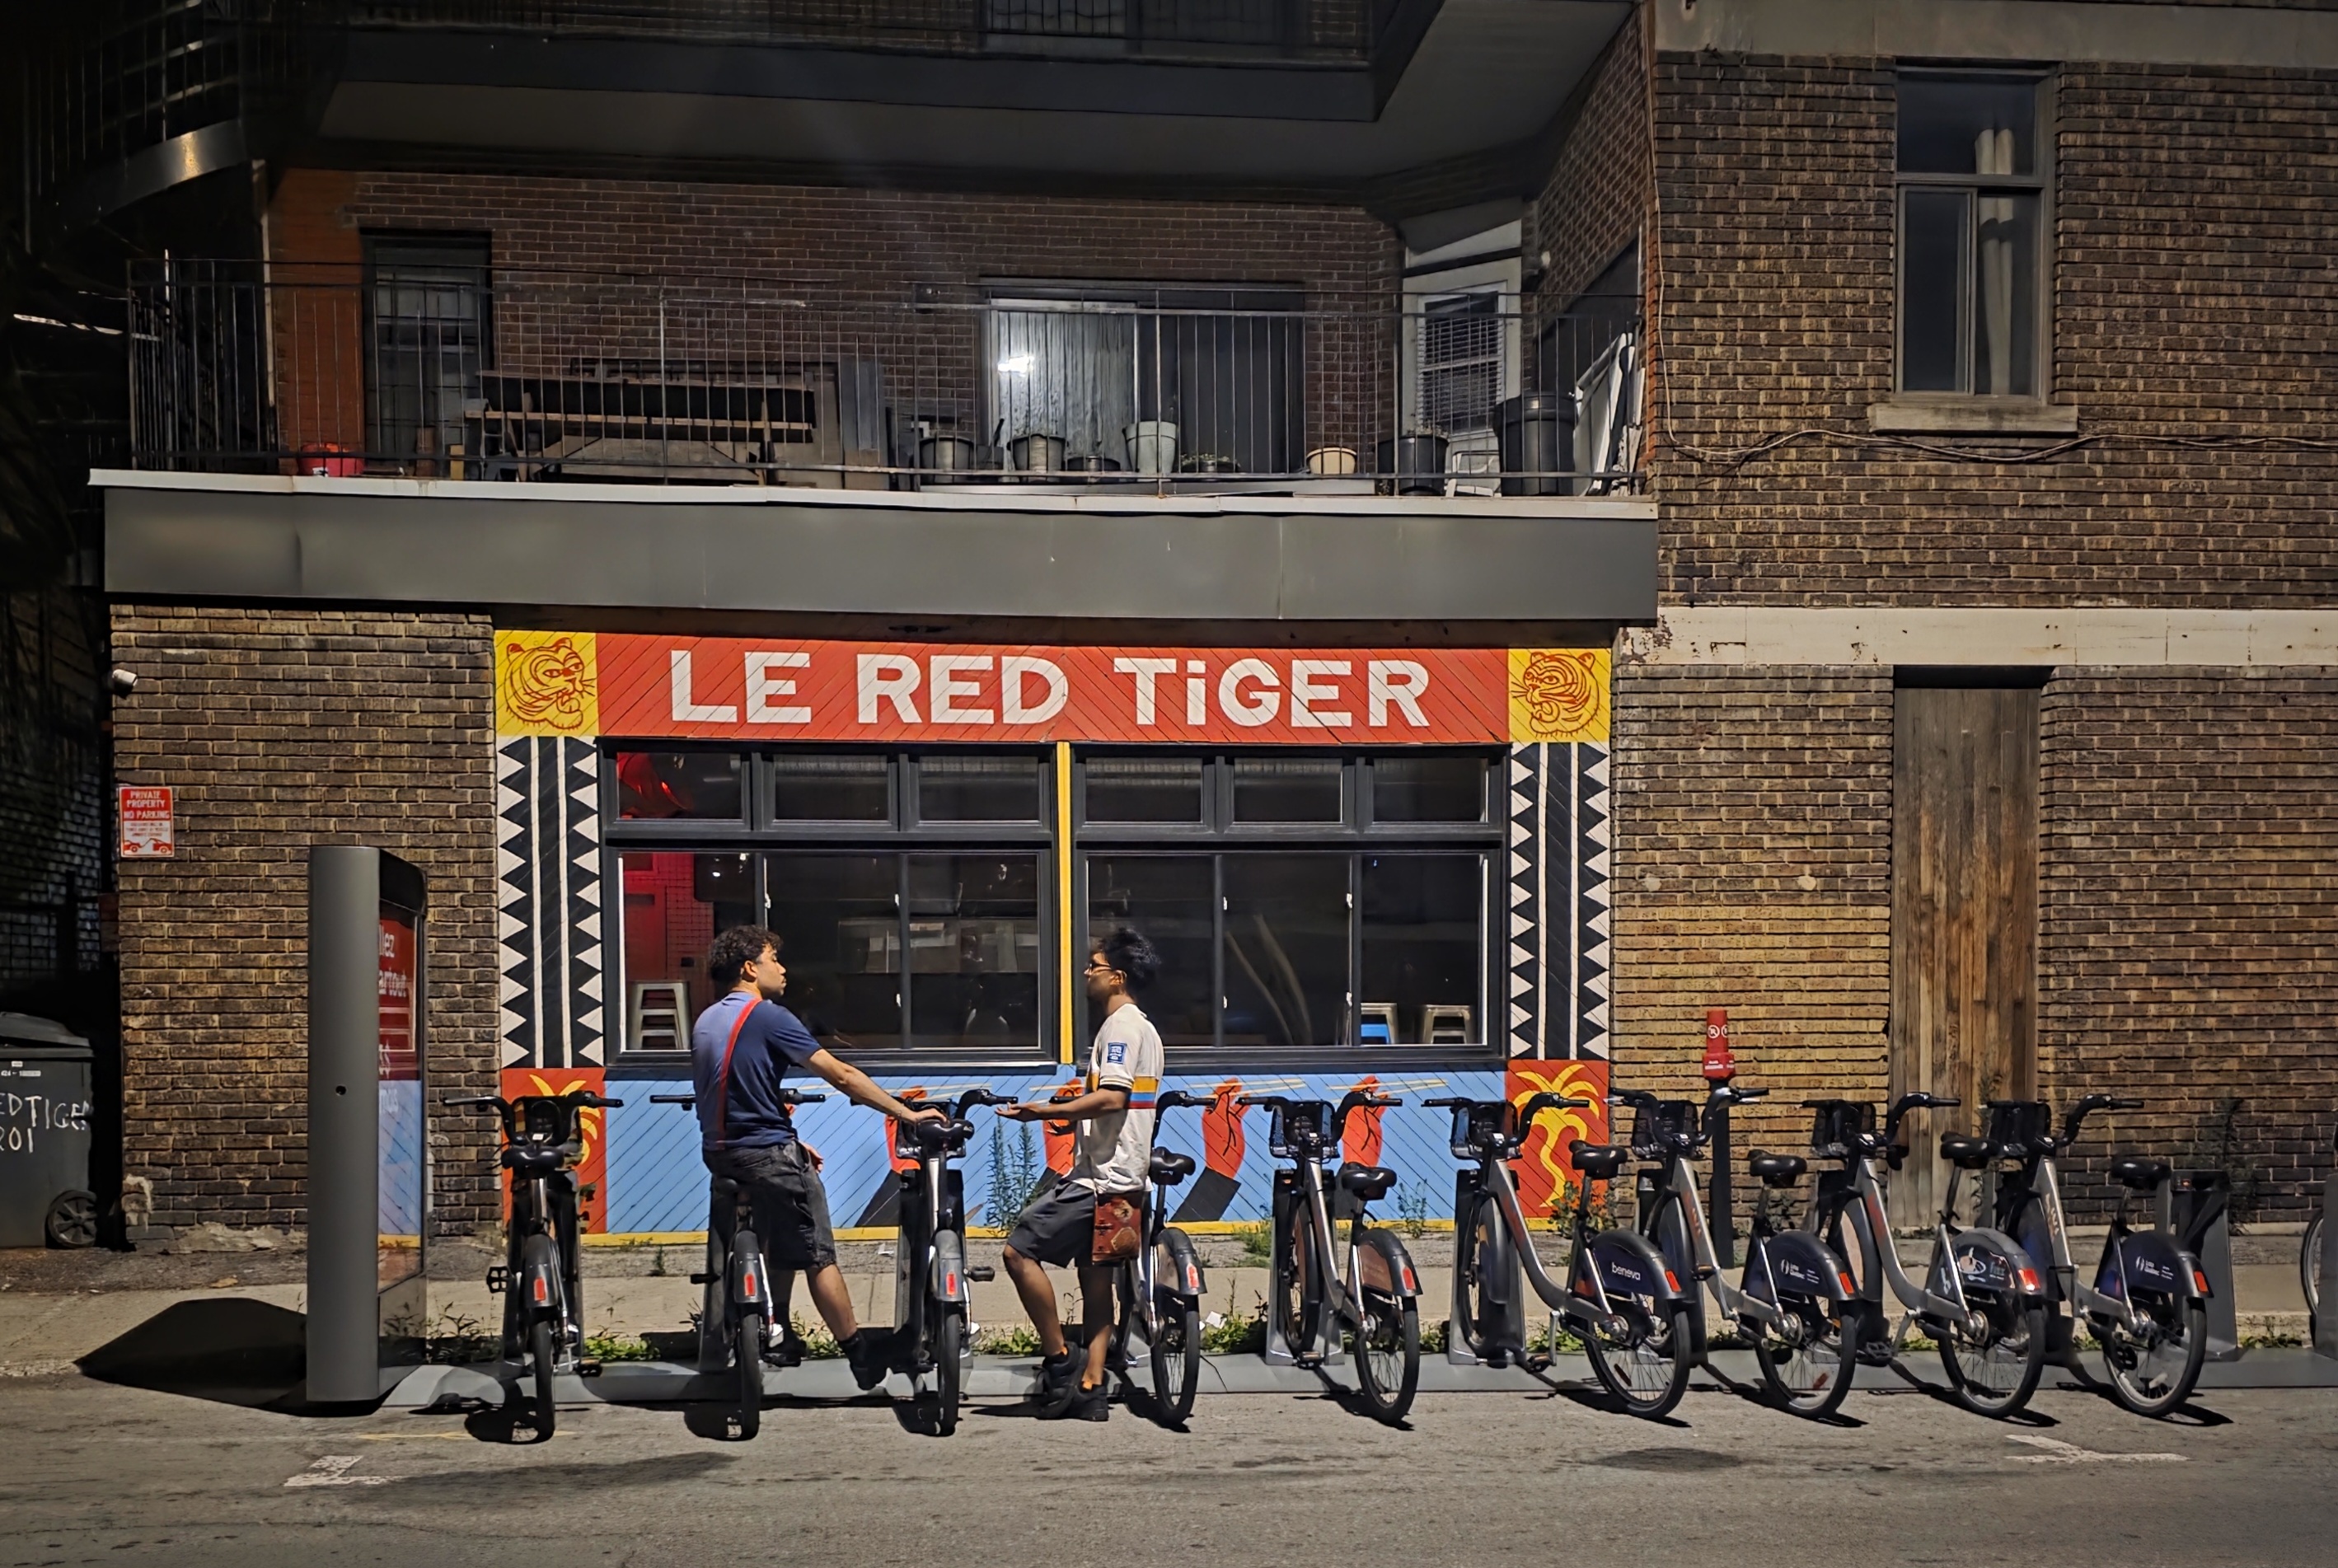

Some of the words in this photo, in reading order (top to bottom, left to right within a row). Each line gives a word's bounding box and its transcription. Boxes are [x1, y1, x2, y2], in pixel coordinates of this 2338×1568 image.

[671, 649, 812, 723] LE
[856, 653, 1070, 725] RED
[130, 790, 162, 799] PRIVATE
[126, 799, 166, 807] PROPERTY
[123, 810, 134, 819] NO
[136, 810, 171, 819] PARKING
[1611, 1261, 1642, 1281] beneva
